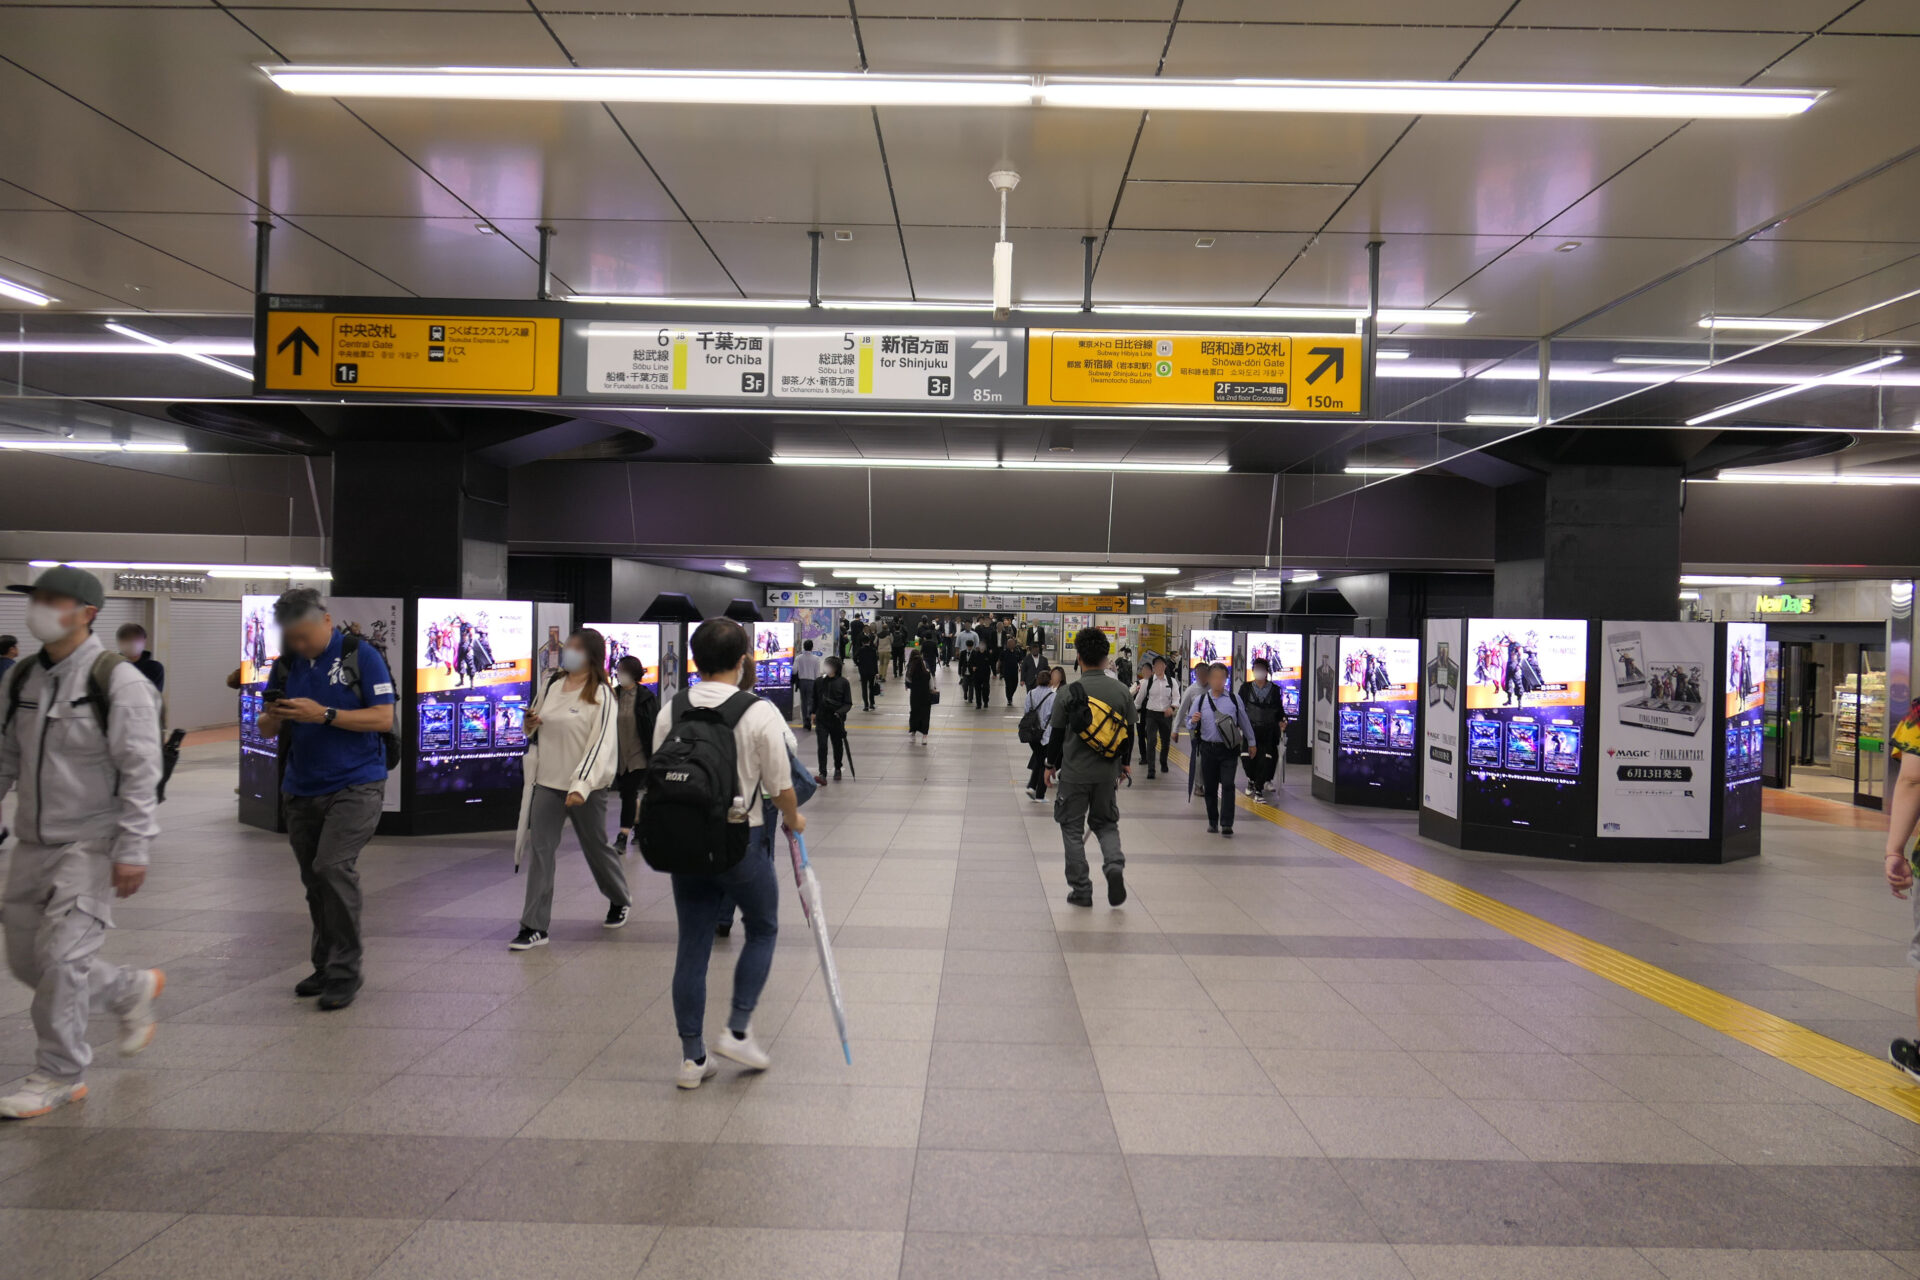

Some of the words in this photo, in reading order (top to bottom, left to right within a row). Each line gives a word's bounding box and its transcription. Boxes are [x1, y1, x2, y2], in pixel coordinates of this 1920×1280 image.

[339, 324, 396, 338] 中央改札
[448, 326, 529, 338] つくばエクスプレス線
[658, 328, 669, 346] 6
[696, 332, 762, 350] 千葉方面
[843, 332, 854, 351] 5
[339, 340, 370, 349] Central
[373, 340, 393, 350] Gate
[881, 335, 948, 355] 新宿方面
[1079, 340, 1112, 348] 東京メトロ
[1115, 340, 1153, 349] 日比谷線
[1201, 342, 1285, 357] 昭和通り改札
[448, 346, 466, 356] バス
[633, 350, 669, 361] 総武線
[706, 354, 721, 364] for
[726, 354, 762, 365] Chiba
[818, 353, 855, 365] 総武線
[880, 358, 896, 368] for
[900, 358, 948, 369] Shinjuku
[1084, 360, 1112, 369] 新宿線
[1264, 359, 1284, 367] Gate
[338, 366, 355, 382] 1F
[606, 372, 668, 382] 船橋・千葉方面
[1088, 370, 1111, 378] Subway
[744, 375, 762, 390] 3F
[782, 376, 854, 386] 御茶ノ水・新宿方面
[931, 379, 948, 394] 3F
[1217, 384, 1231, 394] 2F
[1234, 386, 1284, 394] コンコース経由
[973, 389, 1002, 402] 85m
[1307, 396, 1343, 408] 150m
[1756, 595, 1811, 614] NewDays
[1660, 749, 1677, 760] FINAL
[1679, 749, 1704, 760] FANTASY
[665, 771, 689, 782] ROXY
[1627, 768, 1682, 778] 6月13日発売
